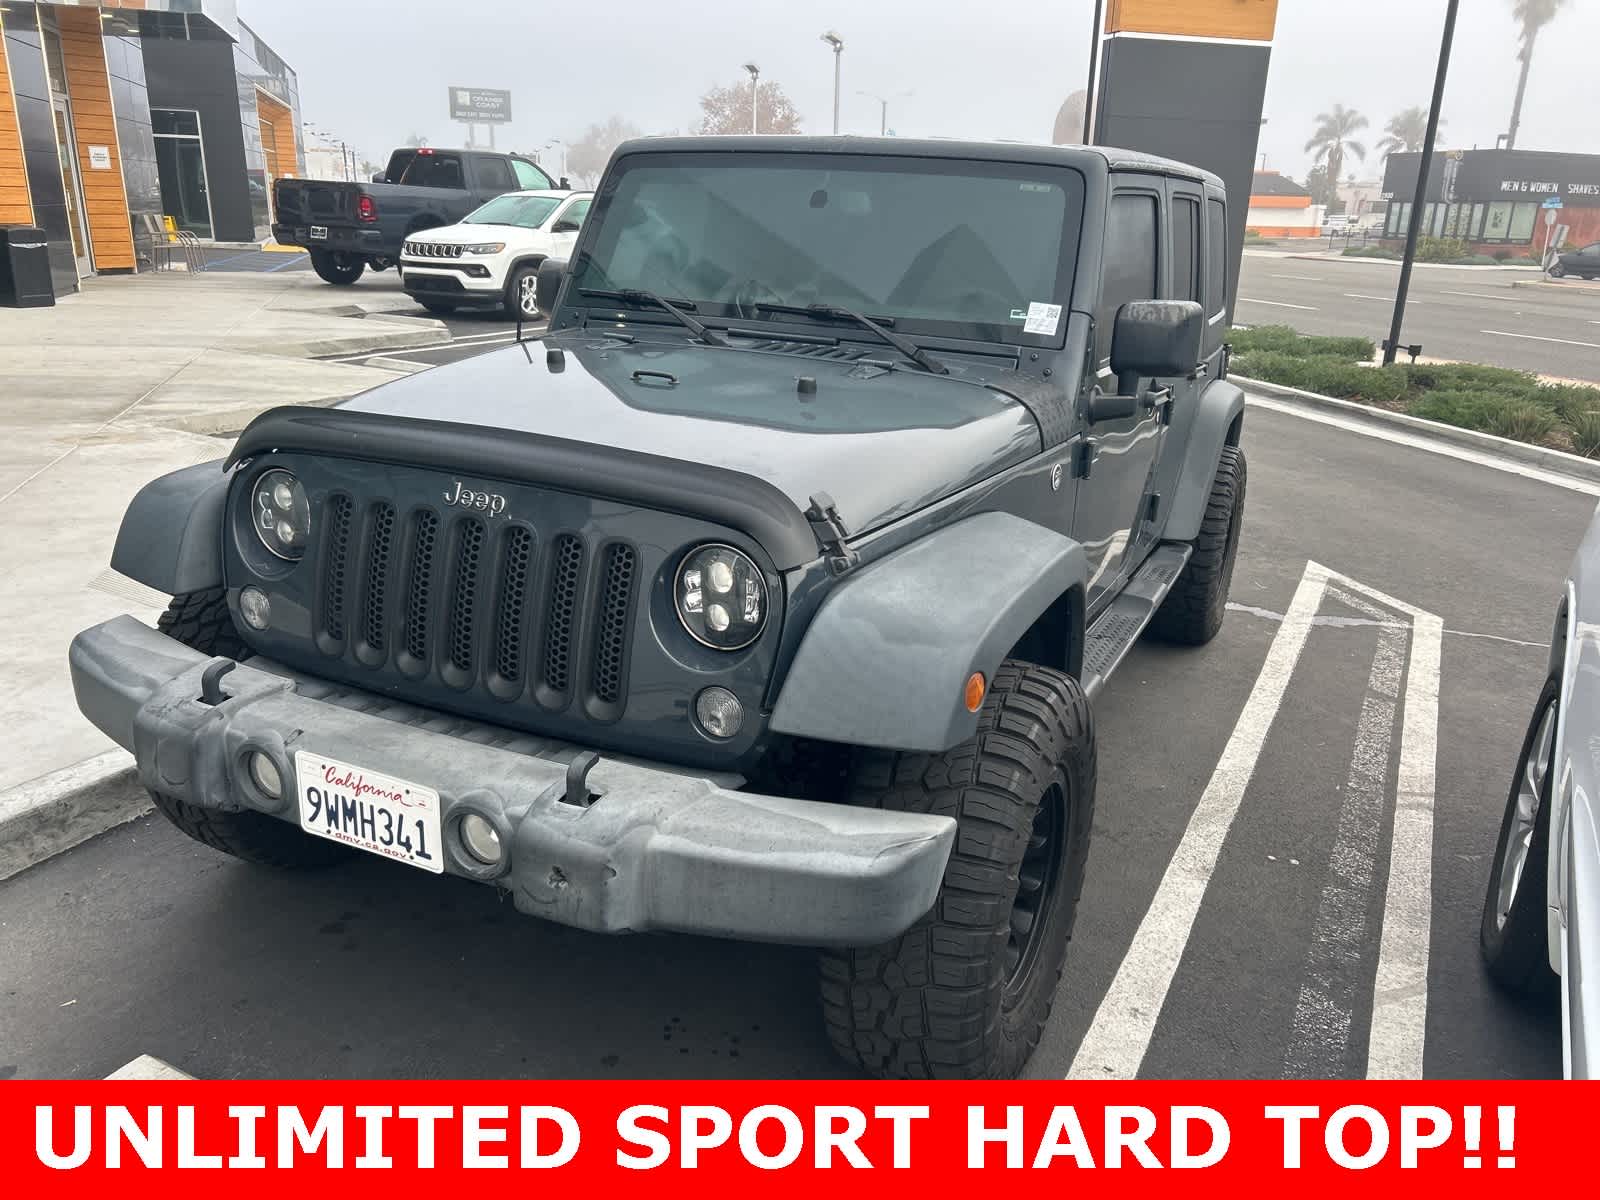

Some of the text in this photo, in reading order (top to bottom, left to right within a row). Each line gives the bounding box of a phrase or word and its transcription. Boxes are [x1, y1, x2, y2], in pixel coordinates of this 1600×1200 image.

[1501, 180, 1520, 192] MEN
[1530, 181, 1559, 193] WOMEN
[1568, 183, 1600, 195] SHAVES
[442, 481, 506, 518] Jeep
[324, 765, 414, 808] California
[306, 786, 433, 861] 9WMH341
